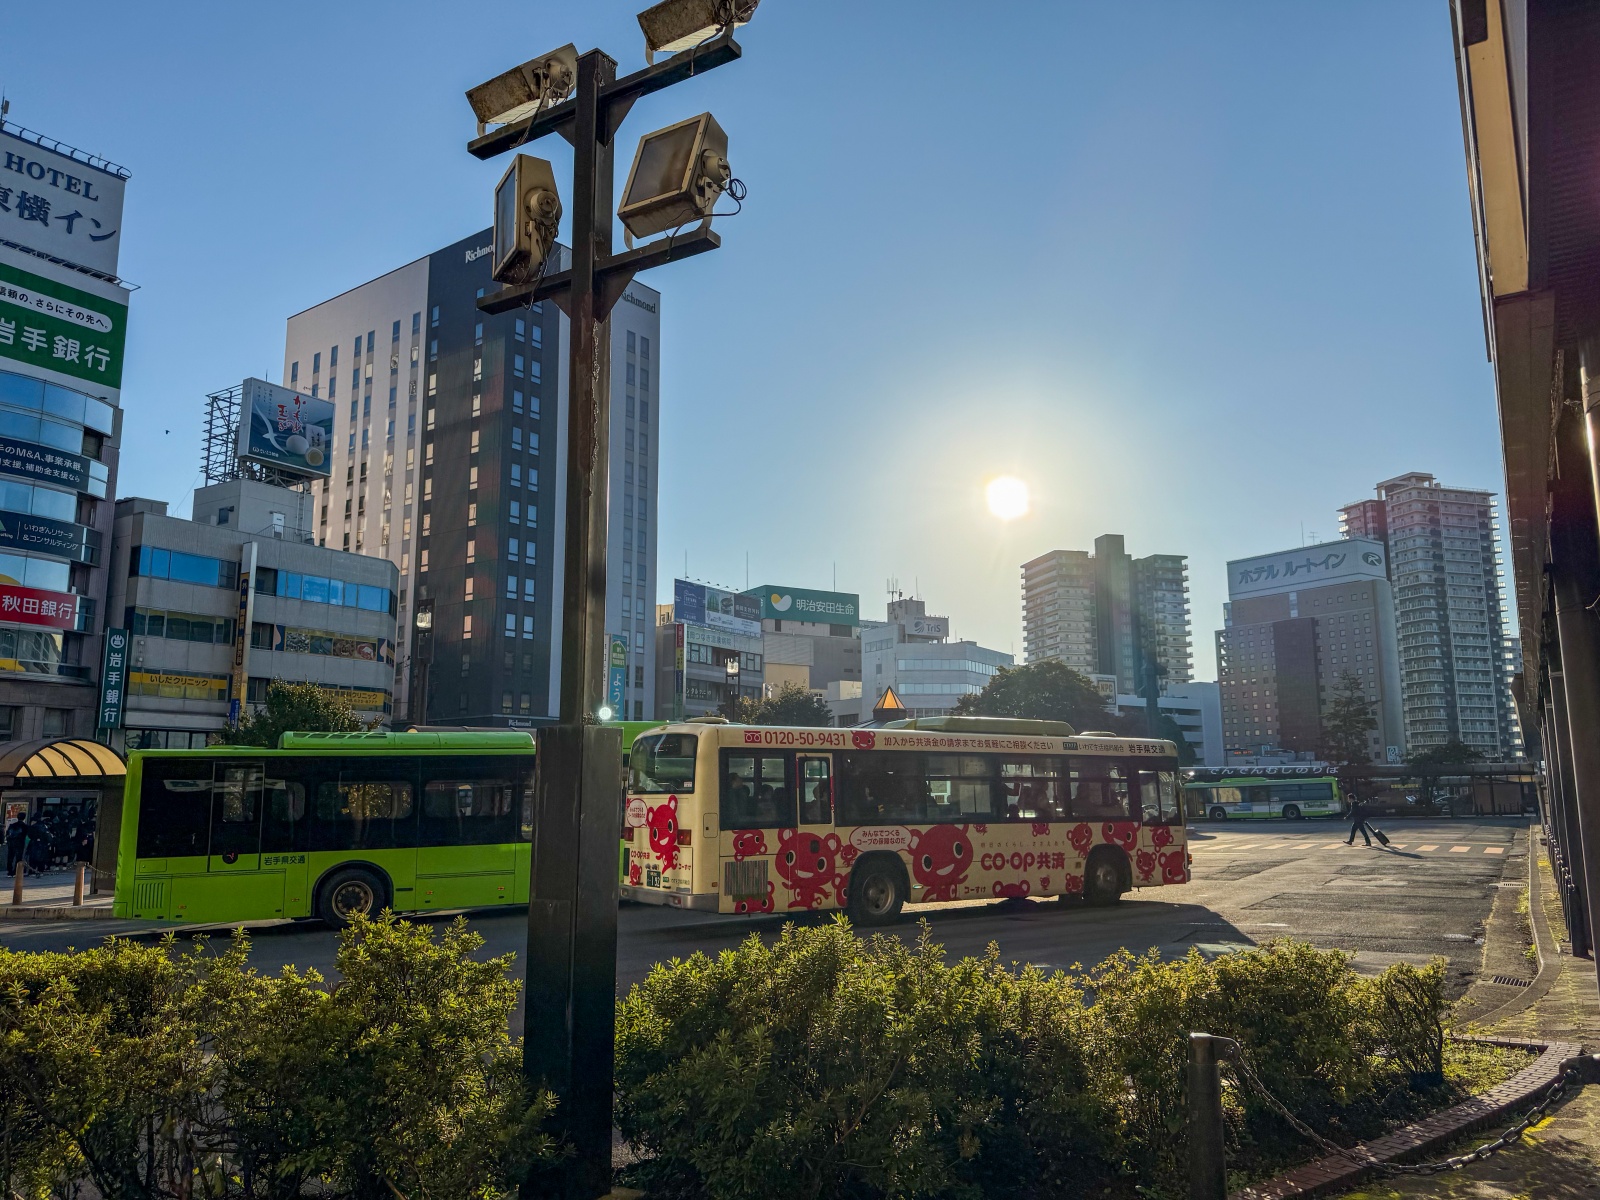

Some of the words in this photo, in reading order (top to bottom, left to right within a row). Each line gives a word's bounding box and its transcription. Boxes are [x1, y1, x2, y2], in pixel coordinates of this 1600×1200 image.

[4, 151, 99, 202] HOTEL
[465, 244, 494, 264] Richmo
[0, 458, 80, 483] 支援、補助金支援なら
[24, 523, 73, 539] いわぎんリサーチ
[23, 534, 79, 550] &コンサルティング
[1239, 564, 1279, 585] ホテル
[1283, 553, 1347, 577] ルートイン
[2, 595, 73, 620] 秋田銀行
[796, 599, 855, 616] 明治安田生命
[104, 652, 122, 723] 岩手銀行
[150, 675, 209, 687] いしだクリニック
[764, 731, 846, 746] 0120-50-9431
[1129, 744, 1166, 754] 岩手県交通
[1209, 766, 1340, 775] でんでんむしのりば
[862, 830, 899, 838] みんなでつくる
[264, 855, 305, 866] 岩手県交通
[964, 886, 986, 894] コーすけ
